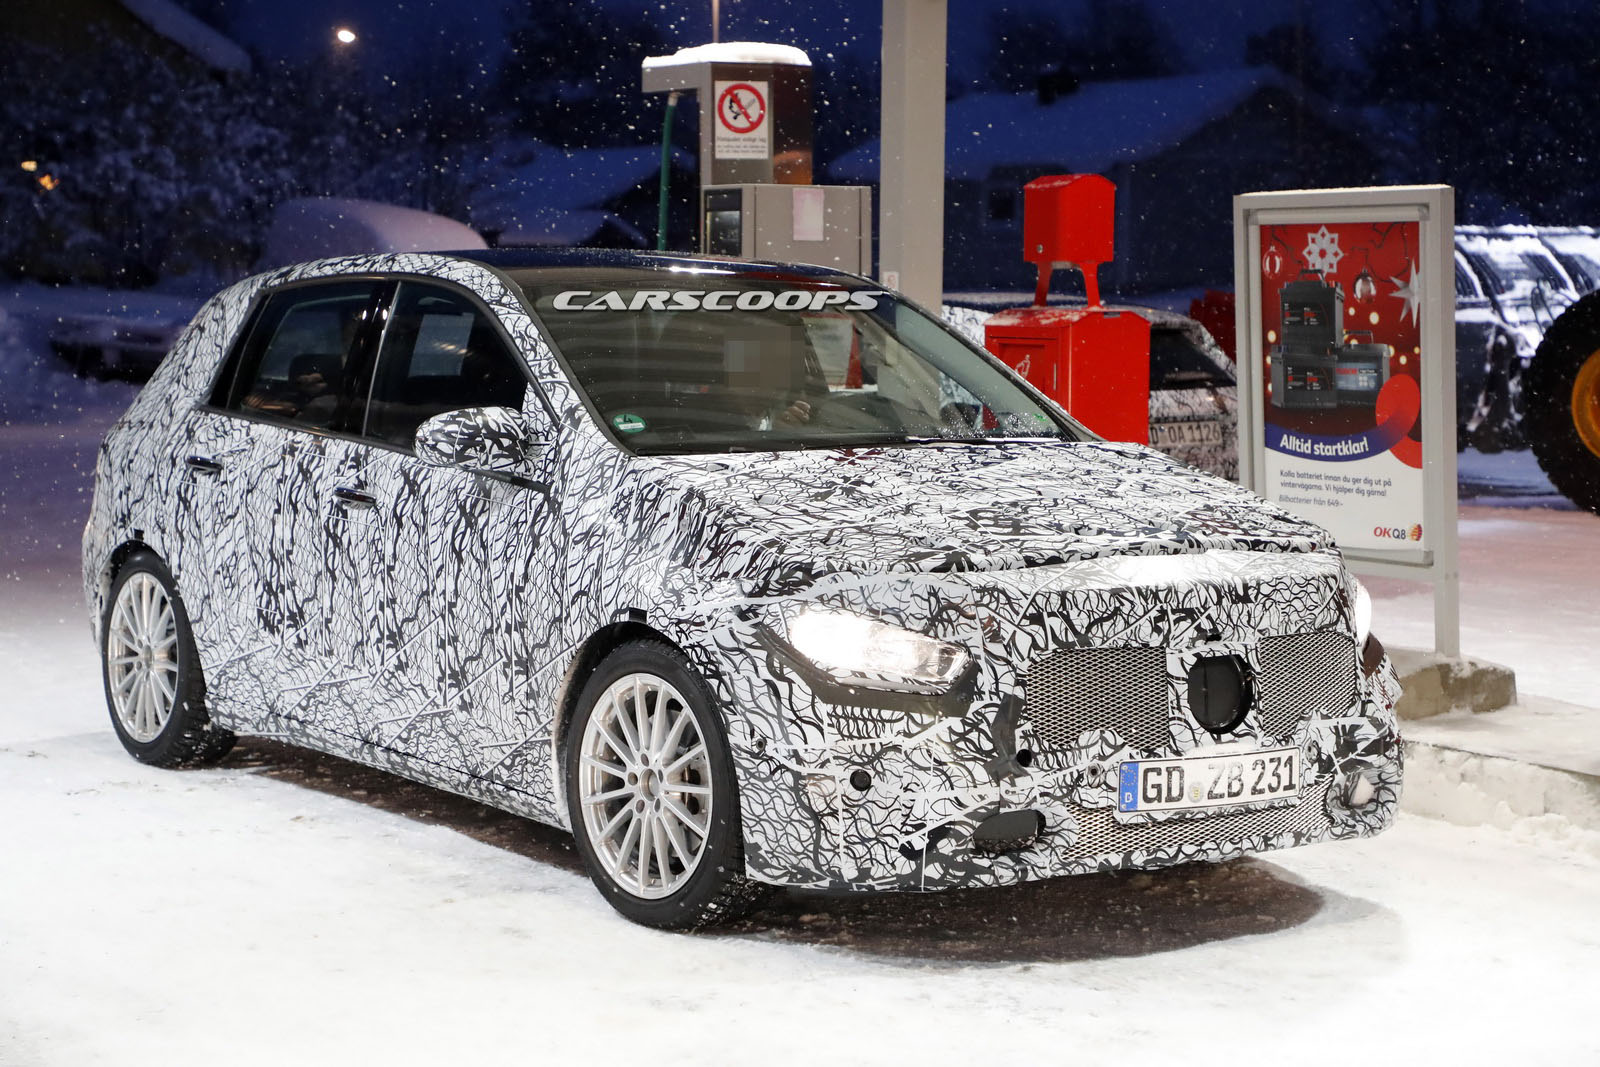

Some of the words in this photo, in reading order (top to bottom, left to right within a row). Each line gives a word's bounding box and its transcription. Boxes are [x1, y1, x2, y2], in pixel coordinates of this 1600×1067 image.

[624, 414, 633, 423] 4
[1187, 423, 1220, 443] 1126
[1280, 433, 1312, 454] Alltid
[1313, 437, 1369, 456] startklar!
[1280, 469, 1295, 478] Kolla
[1296, 471, 1322, 480] batteriet
[1324, 473, 1341, 481] innan
[1342, 475, 1351, 483] du
[1352, 477, 1362, 485] ger
[1363, 477, 1373, 487] dig
[1383, 478, 1392, 487] på
[1325, 483, 1331, 491] Vi
[1355, 487, 1365, 496] dig
[1142, 766, 1185, 804] GD
[1207, 762, 1244, 800] ZB
[1251, 755, 1297, 796] 231
[1124, 792, 1134, 803] D
